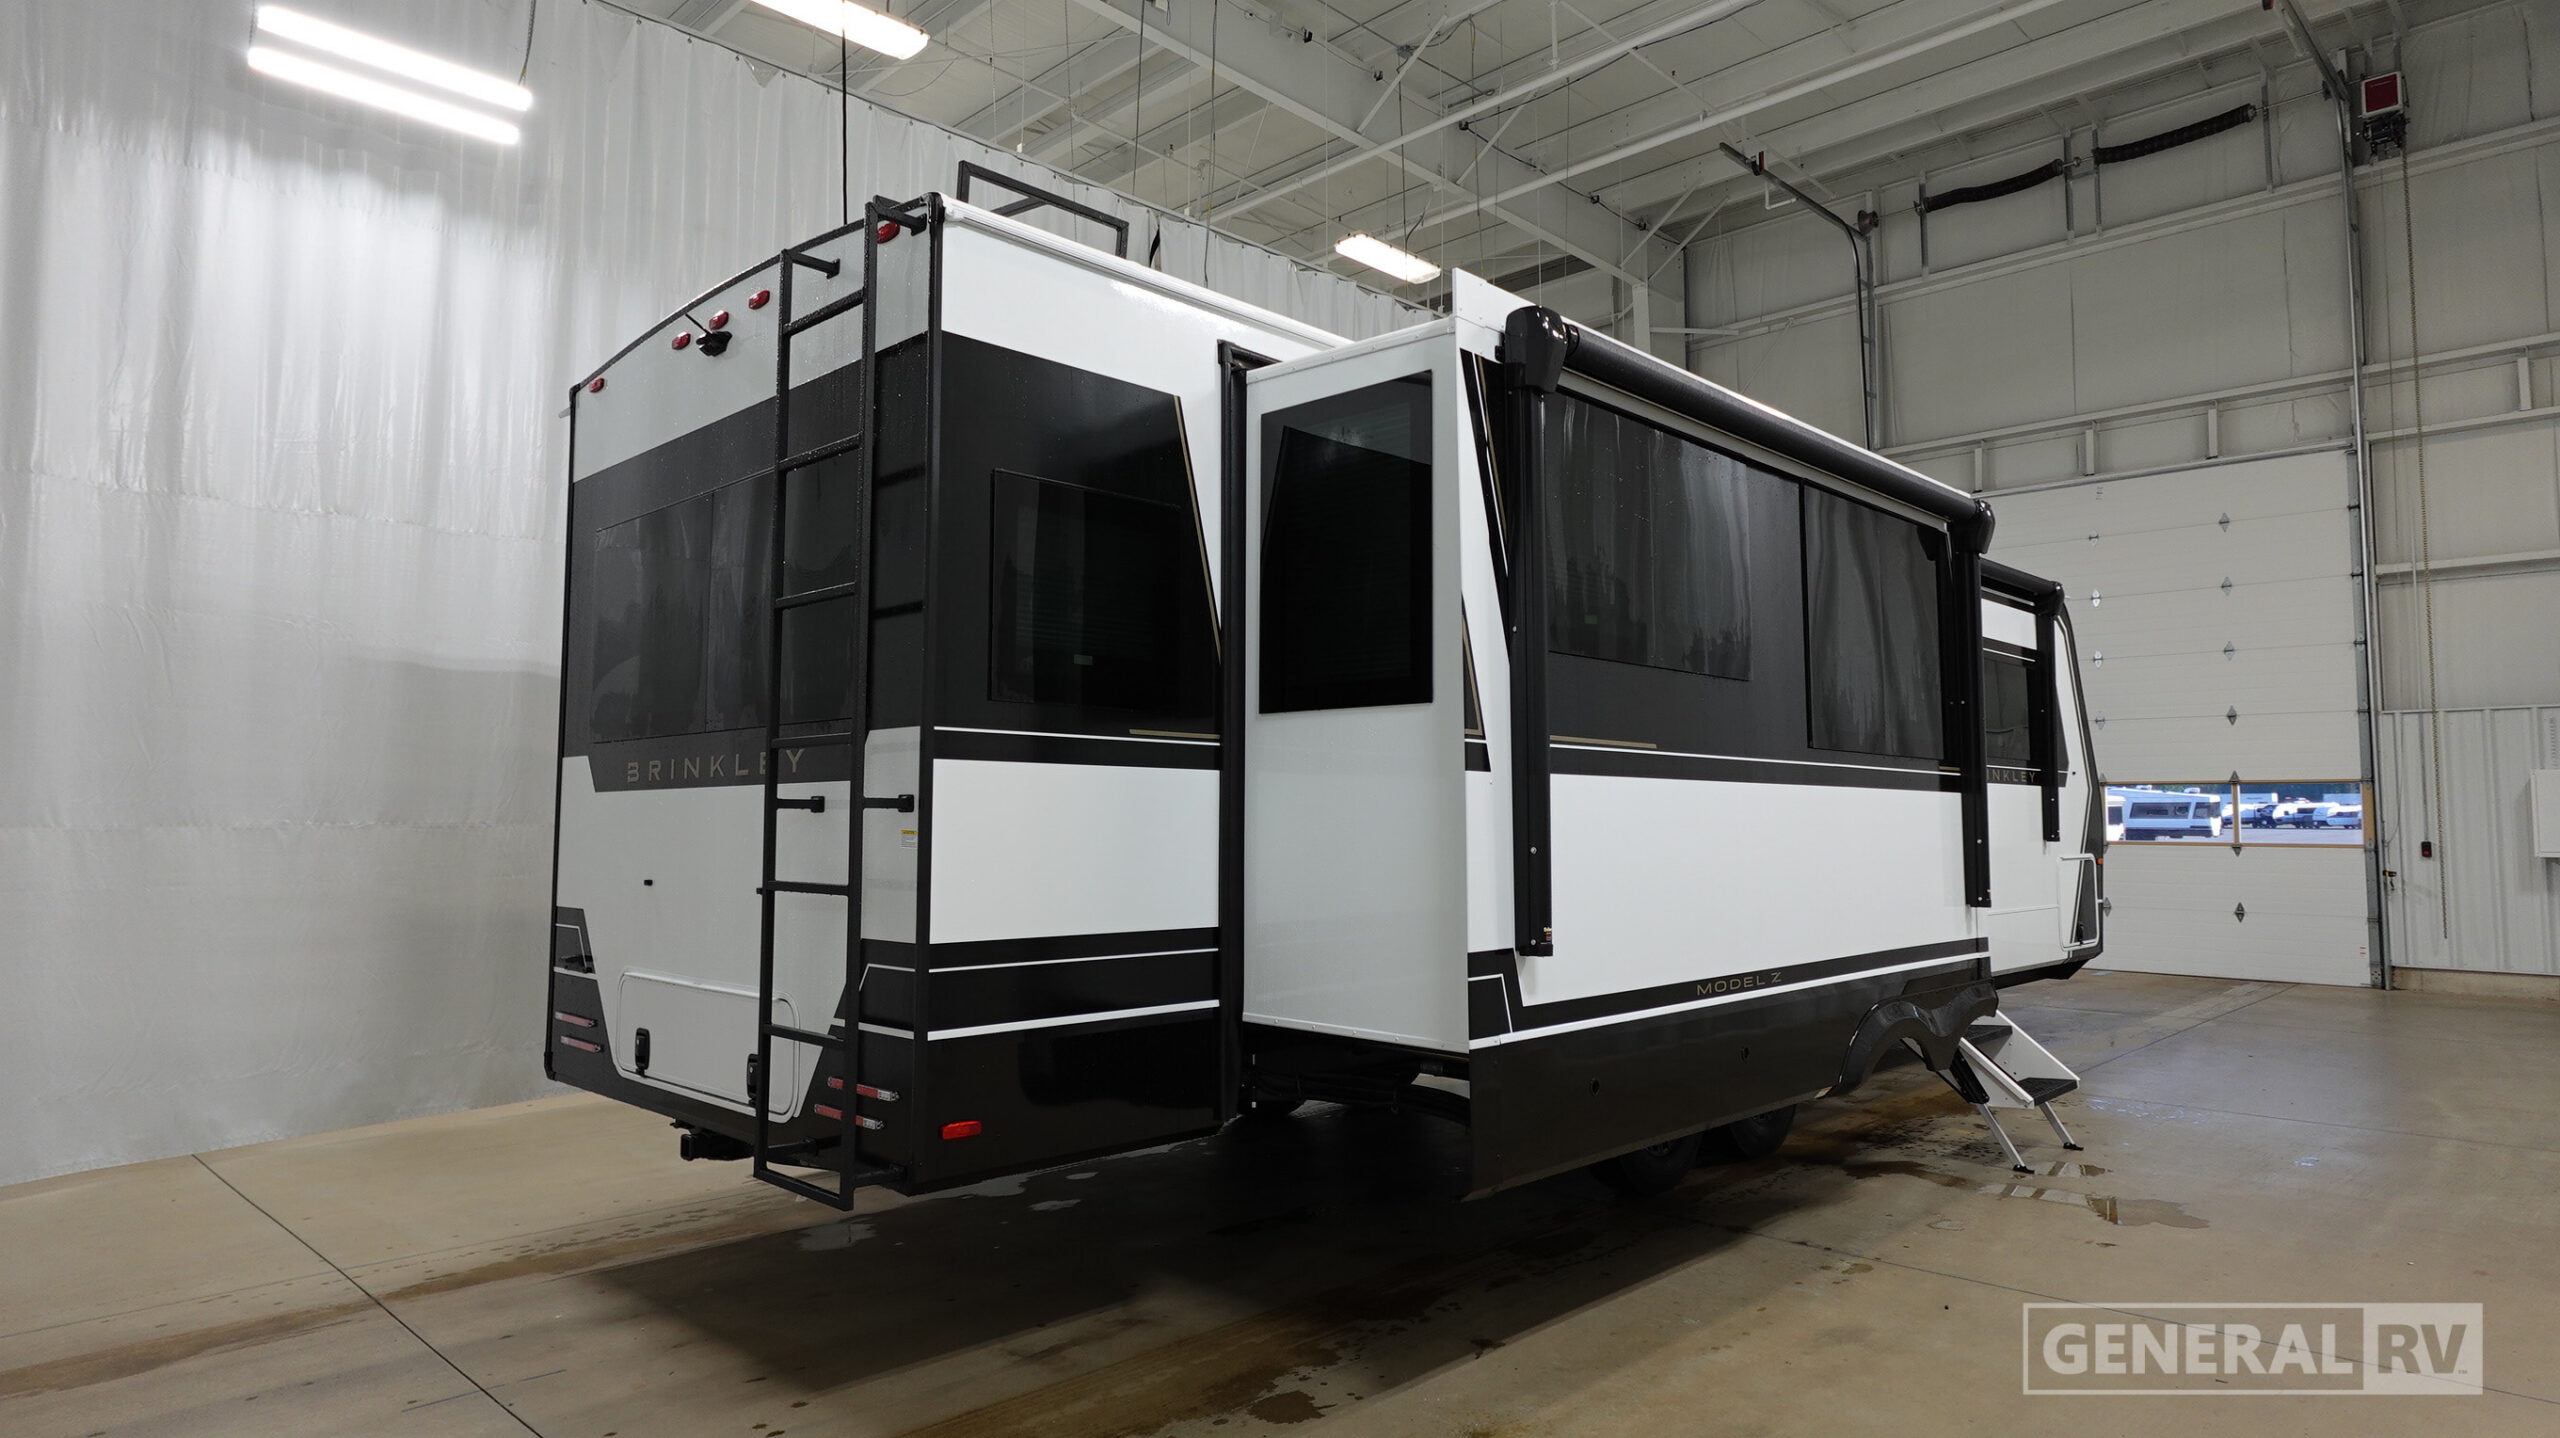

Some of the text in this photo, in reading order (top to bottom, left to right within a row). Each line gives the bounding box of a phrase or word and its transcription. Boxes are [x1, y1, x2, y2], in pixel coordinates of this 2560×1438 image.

[1985, 767, 2036, 784] INKLEY
[1696, 971, 1782, 996] MODEL Z
